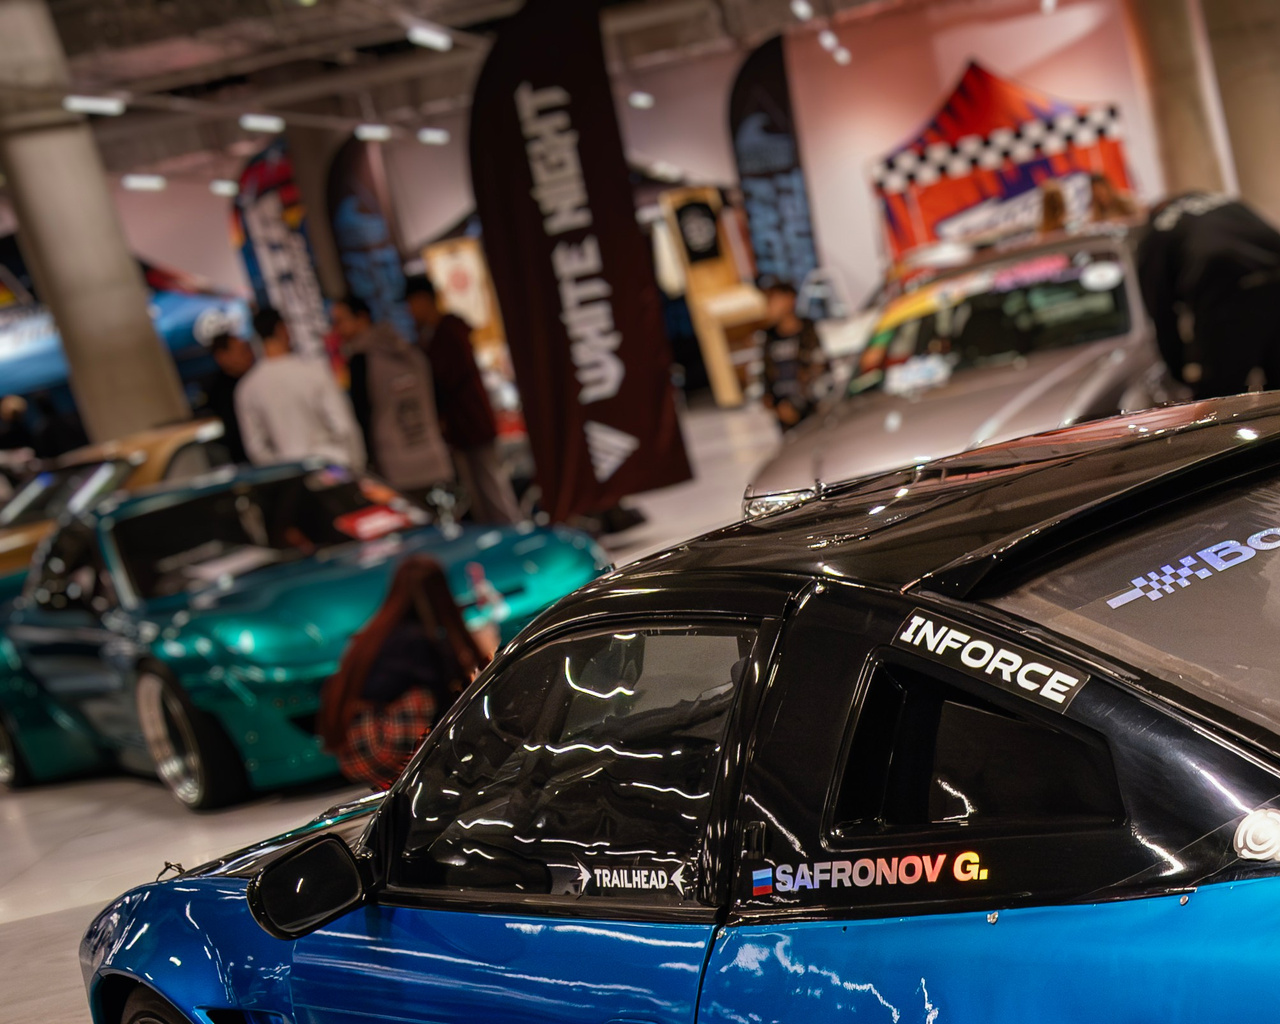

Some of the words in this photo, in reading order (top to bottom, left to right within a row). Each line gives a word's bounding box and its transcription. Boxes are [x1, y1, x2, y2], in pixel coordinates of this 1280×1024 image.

[514, 81, 592, 236] NIGHT
[551, 235, 625, 404] WHITE
[900, 615, 1079, 704] INFORCE
[593, 868, 668, 890] TRAILHEAD
[775, 854, 947, 893] SAFRONOV
[953, 851, 988, 882] G.
